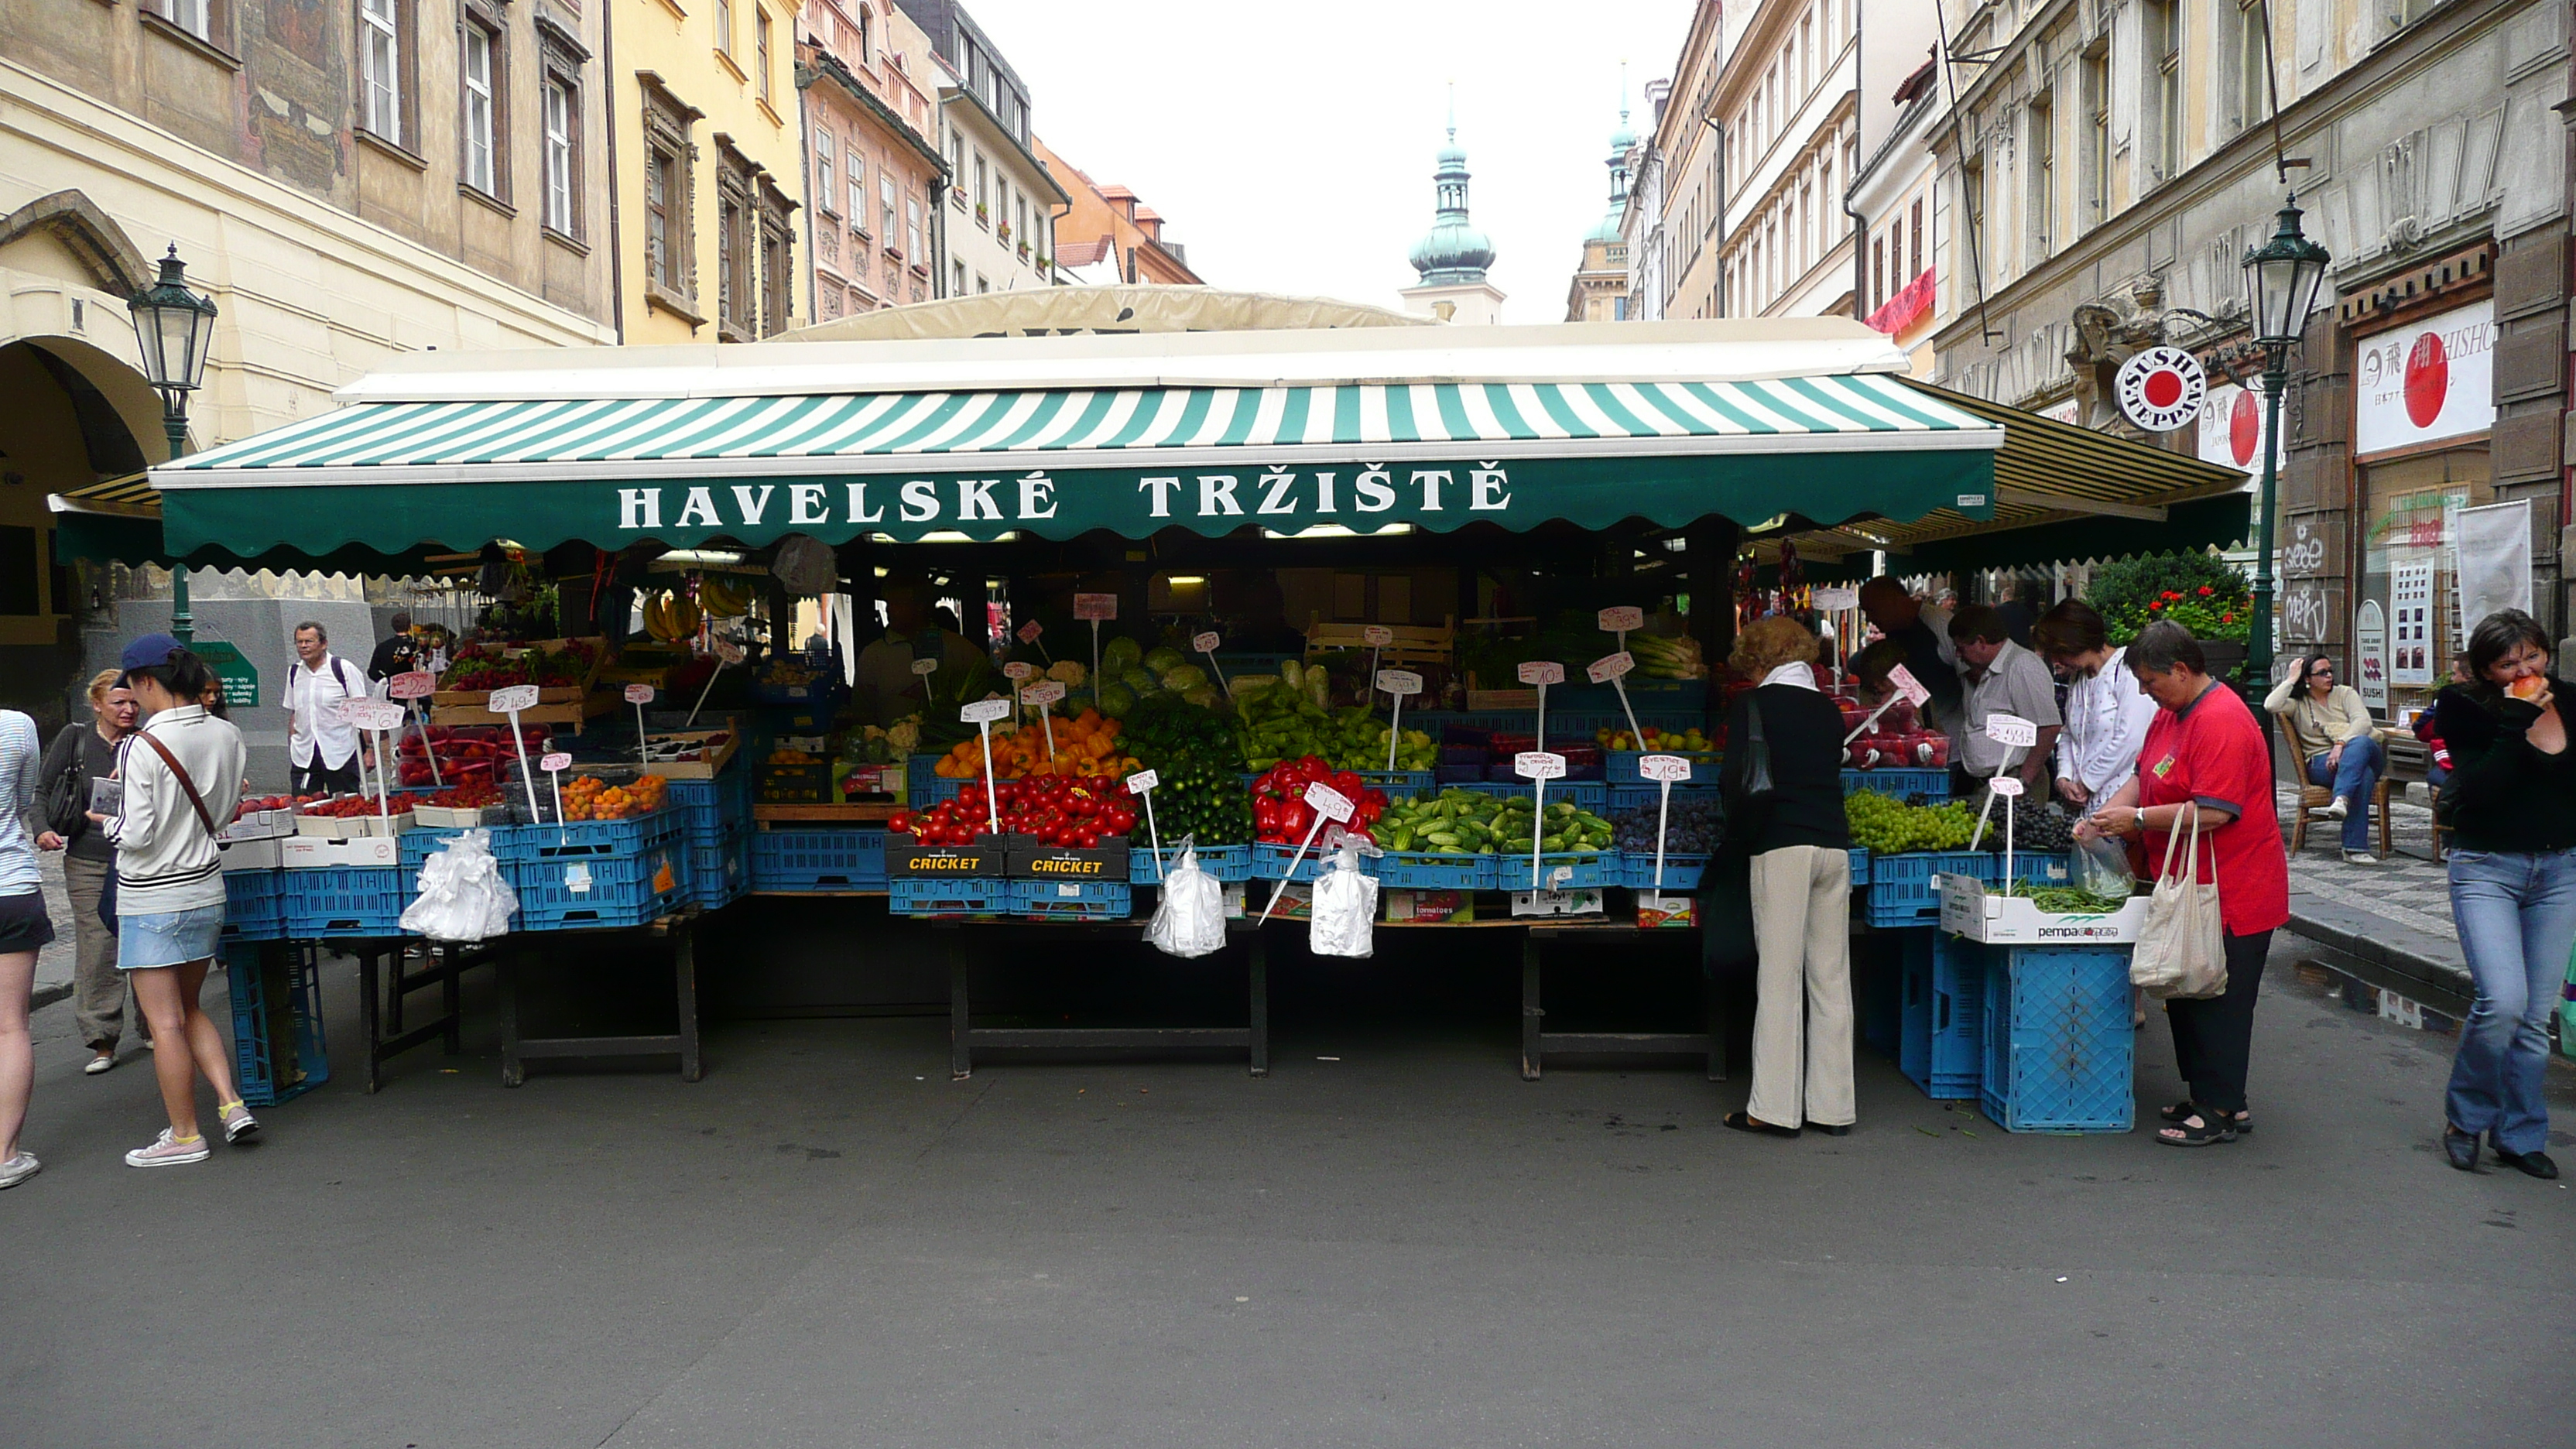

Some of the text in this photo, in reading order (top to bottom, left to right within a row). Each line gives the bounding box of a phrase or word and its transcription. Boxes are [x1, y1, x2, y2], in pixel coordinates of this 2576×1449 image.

[2125, 350, 2202, 389] SUSHI
[2126, 389, 2202, 426] TEPPAN
[618, 461, 1512, 529] HAVELSKÉ TRŽIŠTĚ
[2362, 687, 2383, 698] SUSHI
[909, 858, 979, 870] CRICKET
[1031, 859, 1102, 873] CRICKET
